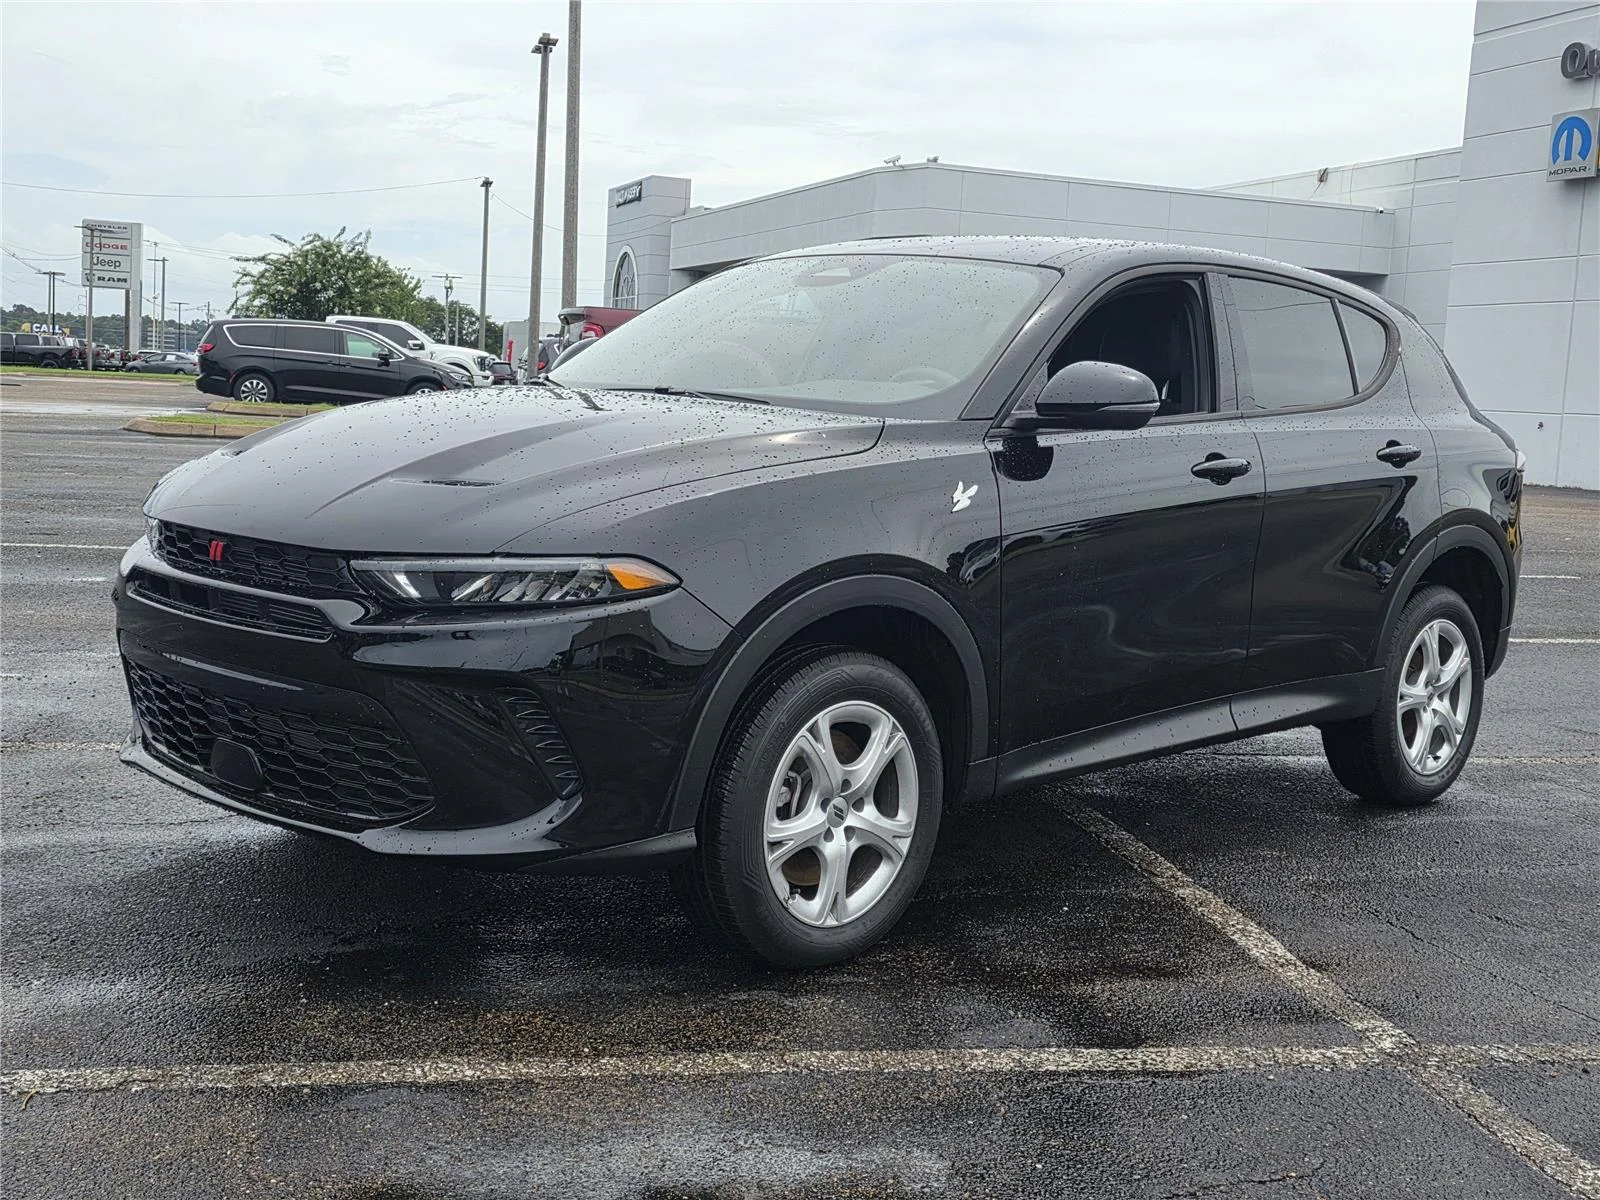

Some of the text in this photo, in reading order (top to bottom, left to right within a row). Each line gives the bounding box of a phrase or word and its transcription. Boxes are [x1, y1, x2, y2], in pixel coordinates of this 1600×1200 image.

[1549, 165, 1588, 176] MOPAR
[85, 242, 128, 251] DODGE
[92, 256, 121, 269] Jeep
